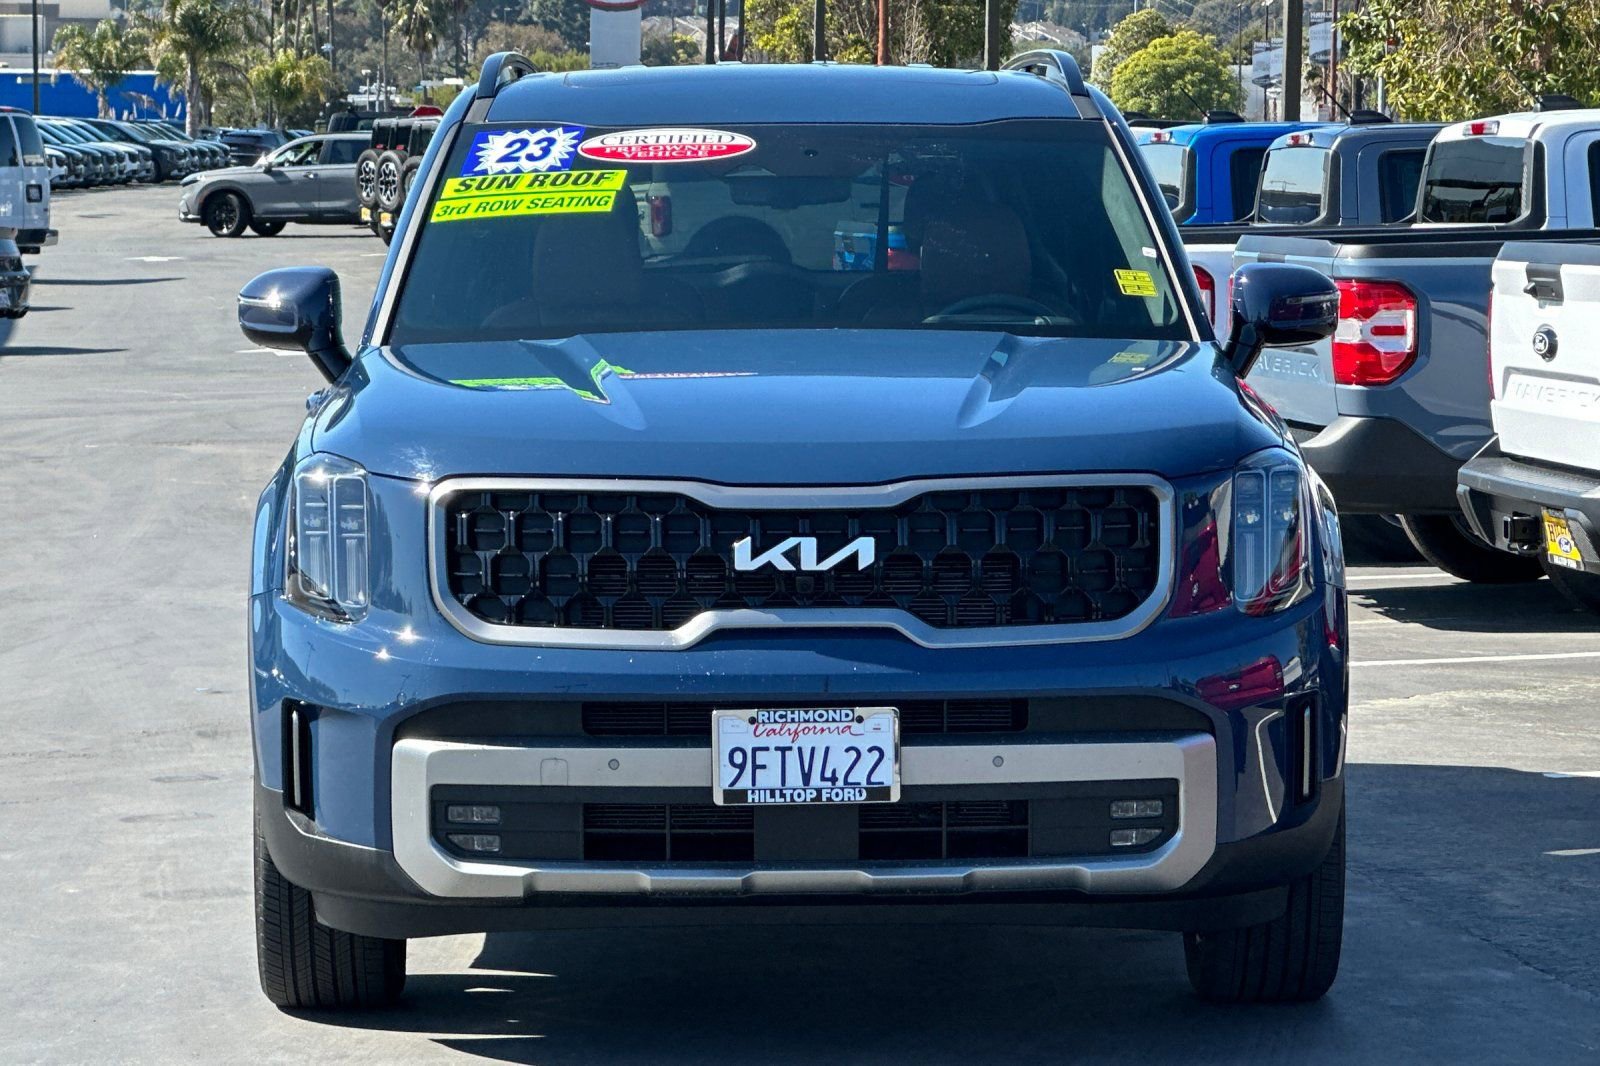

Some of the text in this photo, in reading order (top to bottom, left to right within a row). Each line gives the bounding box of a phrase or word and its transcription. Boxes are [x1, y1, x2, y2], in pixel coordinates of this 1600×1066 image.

[496, 137, 557, 163] 23
[600, 134, 735, 145] CERTIFIED
[605, 144, 728, 153] PRE-OWNED
[623, 150, 709, 158] VEHICLE
[453, 171, 616, 193] SUN ROOF
[436, 195, 612, 218] 3rd ROW SEATING
[1255, 355, 1319, 378] AVERICK
[734, 536, 875, 571] KIA
[757, 709, 854, 723] RICHMOND
[753, 723, 864, 743] California
[728, 745, 885, 788] 9FTV422
[747, 788, 867, 803] HILLTOP FORD
